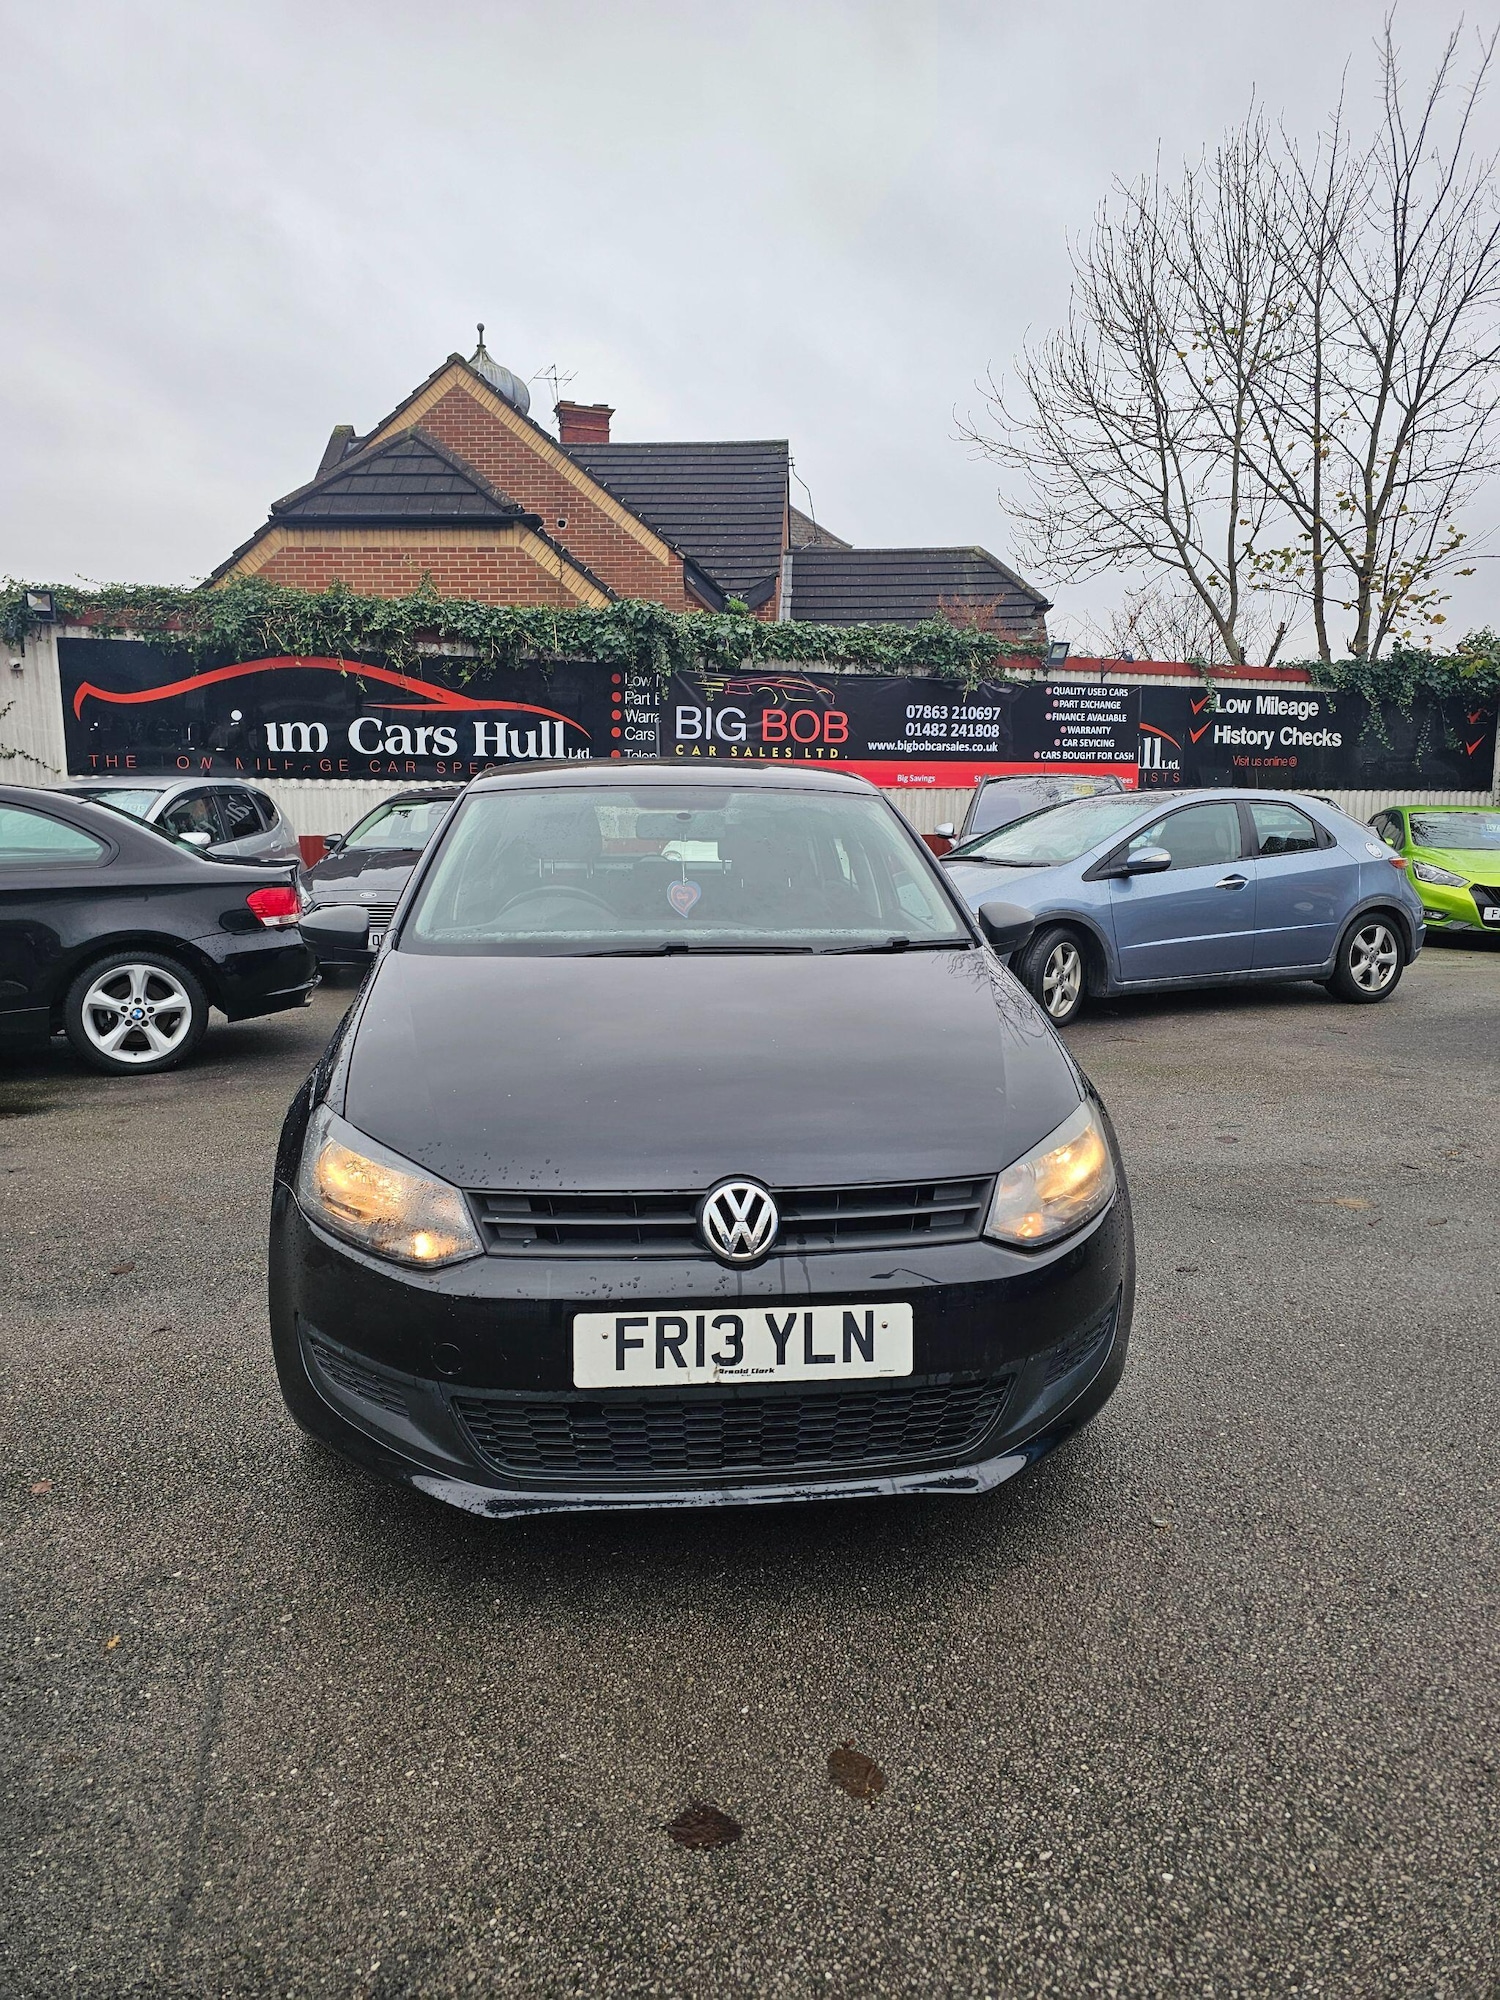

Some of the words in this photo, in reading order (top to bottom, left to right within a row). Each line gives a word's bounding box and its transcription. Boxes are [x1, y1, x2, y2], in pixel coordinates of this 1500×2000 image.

[625, 672, 652, 687] Low
[624, 691, 650, 706] Part
[1053, 687, 1086, 696] QUALITY
[1088, 688, 1108, 696] USED
[1109, 688, 1128, 697] CARS
[906, 704, 948, 720] 07863
[952, 706, 1001, 721] 210697
[1060, 700, 1078, 708] PART
[1080, 700, 1122, 710] EXCHANGE
[1216, 694, 1252, 714] Low
[1256, 696, 1319, 721] Mileage
[676, 706, 747, 742] BIG
[762, 709, 849, 743] BOB
[1052, 712, 1086, 722] FINANCE
[1086, 713, 1127, 722] AVALIABLE
[624, 726, 655, 741] Cars
[906, 722, 948, 736] 01482
[950, 724, 1000, 738] 241808
[1067, 726, 1112, 734] WARRANTY
[1214, 725, 1275, 750] History
[1280, 726, 1342, 747] Checks
[348, 717, 458, 758] Cars
[473, 720, 566, 758] Hull
[568, 747, 592, 759] Ltd.
[1062, 738, 1078, 747] CAR
[1080, 739, 1114, 748] SEVICING
[675, 745, 718, 756] CAR
[731, 746, 792, 758] SALES
[804, 748, 849, 760] LTD.
[868, 740, 998, 752] www.bigbobcarsales.co.uk
[1041, 751, 1061, 760] CARS
[1062, 752, 1096, 760] BOUGHT
[1098, 752, 1112, 760] FOR
[1115, 752, 1134, 760] CASH
[1232, 756, 1250, 767] Visit
[1252, 758, 1262, 767] us
[88, 754, 137, 768] THE
[369, 760, 416, 774] CAR
[1162, 760, 1180, 770] Ltd.
[897, 775, 909, 783] Big
[910, 775, 935, 783] Savings
[615, 1314, 744, 1371] FR13
[764, 1310, 874, 1366] YLN
